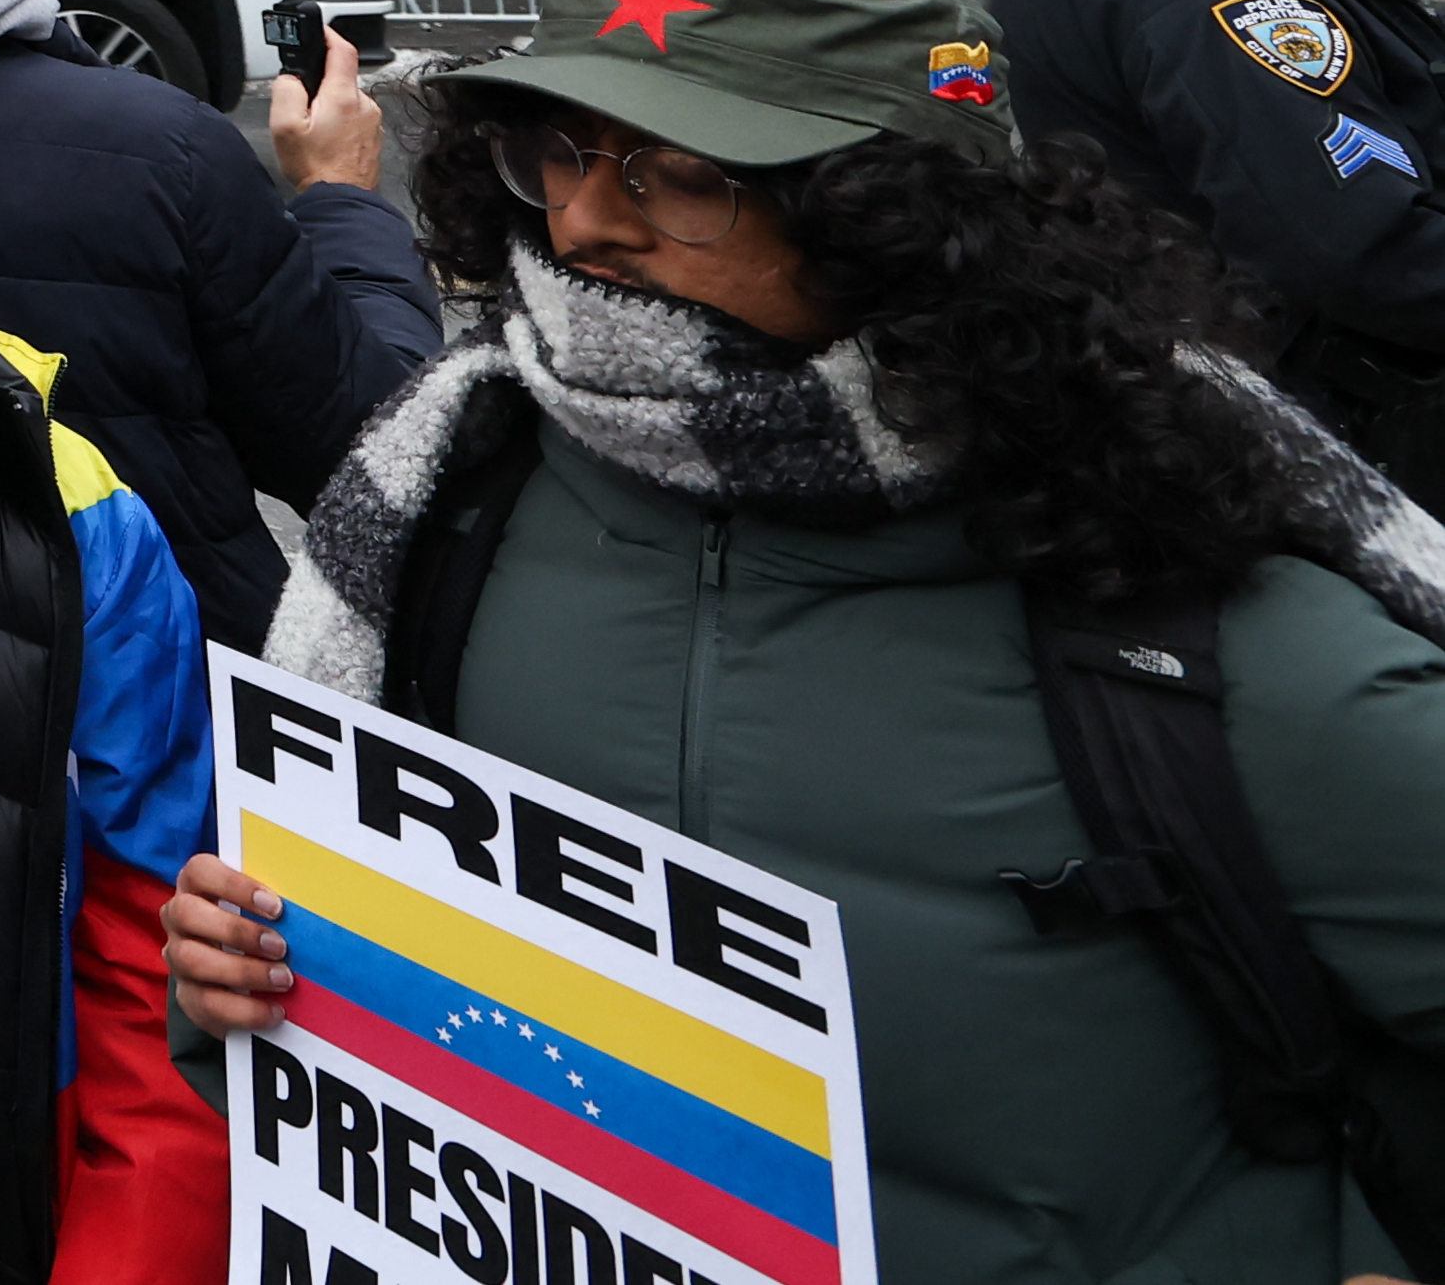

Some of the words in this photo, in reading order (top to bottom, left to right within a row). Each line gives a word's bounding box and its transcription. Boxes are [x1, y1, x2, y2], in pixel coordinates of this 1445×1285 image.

[1232, 8, 1330, 31] DEPARTMENT
[1331, 28, 1348, 57] YORK
[1245, 40, 1280, 65] CITY
[1279, 64, 1305, 80] OF
[1324, 60, 1345, 82] NEW
[1118, 649, 1160, 667] NORTH
[1137, 645, 1160, 658] THE
[1131, 660, 1160, 674] FACE
[231, 675, 829, 1036] FREE
